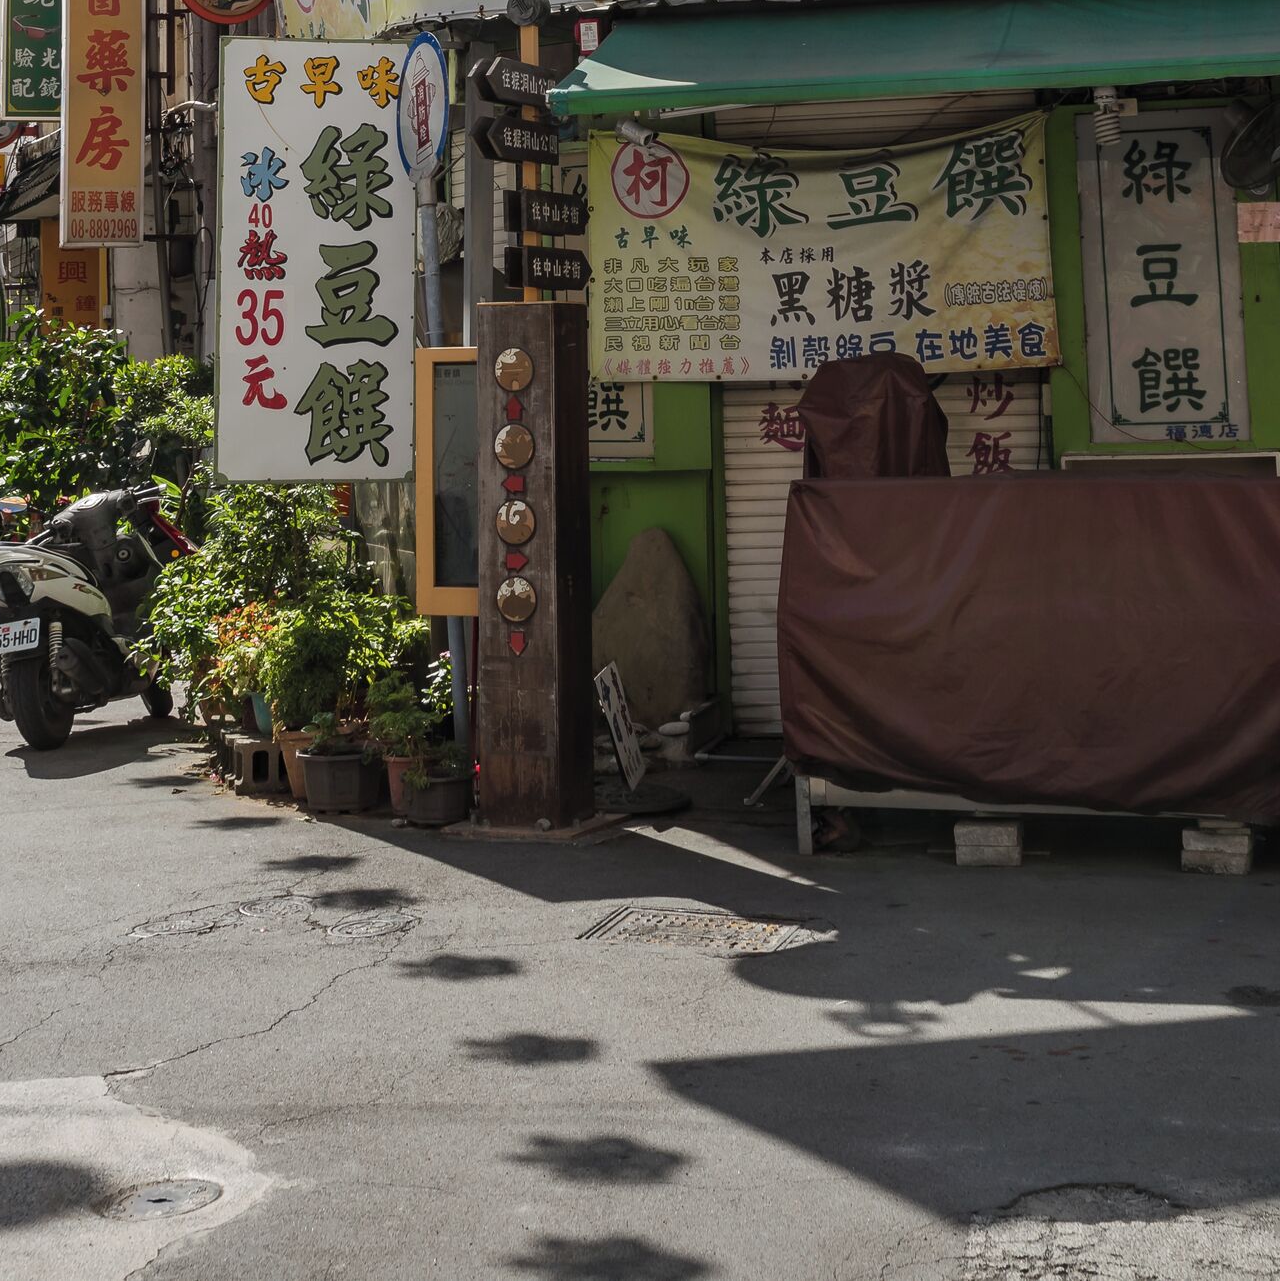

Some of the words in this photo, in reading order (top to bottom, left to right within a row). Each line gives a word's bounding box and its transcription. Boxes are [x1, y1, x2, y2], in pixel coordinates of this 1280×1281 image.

[243, 53, 402, 110] 古早味
[416, 84, 428, 142] 消防栓
[622, 148, 674, 208] 柯
[712, 128, 1036, 239] 綠豆饌
[70, 188, 136, 213] 服務專線
[531, 201, 580, 225] 往中山老街
[69, 213, 139, 241] 08-8892969
[613, 224, 693, 250] 古早味
[532, 257, 582, 280] 往中山老街
[603, 256, 739, 275] 非凡大玩家
[758, 246, 835, 265] 本店採用
[603, 275, 740, 294] 大口吃遍台灣
[1121, 138, 1207, 415] 綠豆饌
[293, 122, 401, 468] 綠豆饌
[769, 259, 937, 328] 黑糖漿
[603, 315, 741, 332] 三立用心看台灣
[603, 334, 741, 352] 民視新聞台
[914, 321, 1047, 364] 在地美食
[1166, 424, 1239, 440] 福德店
